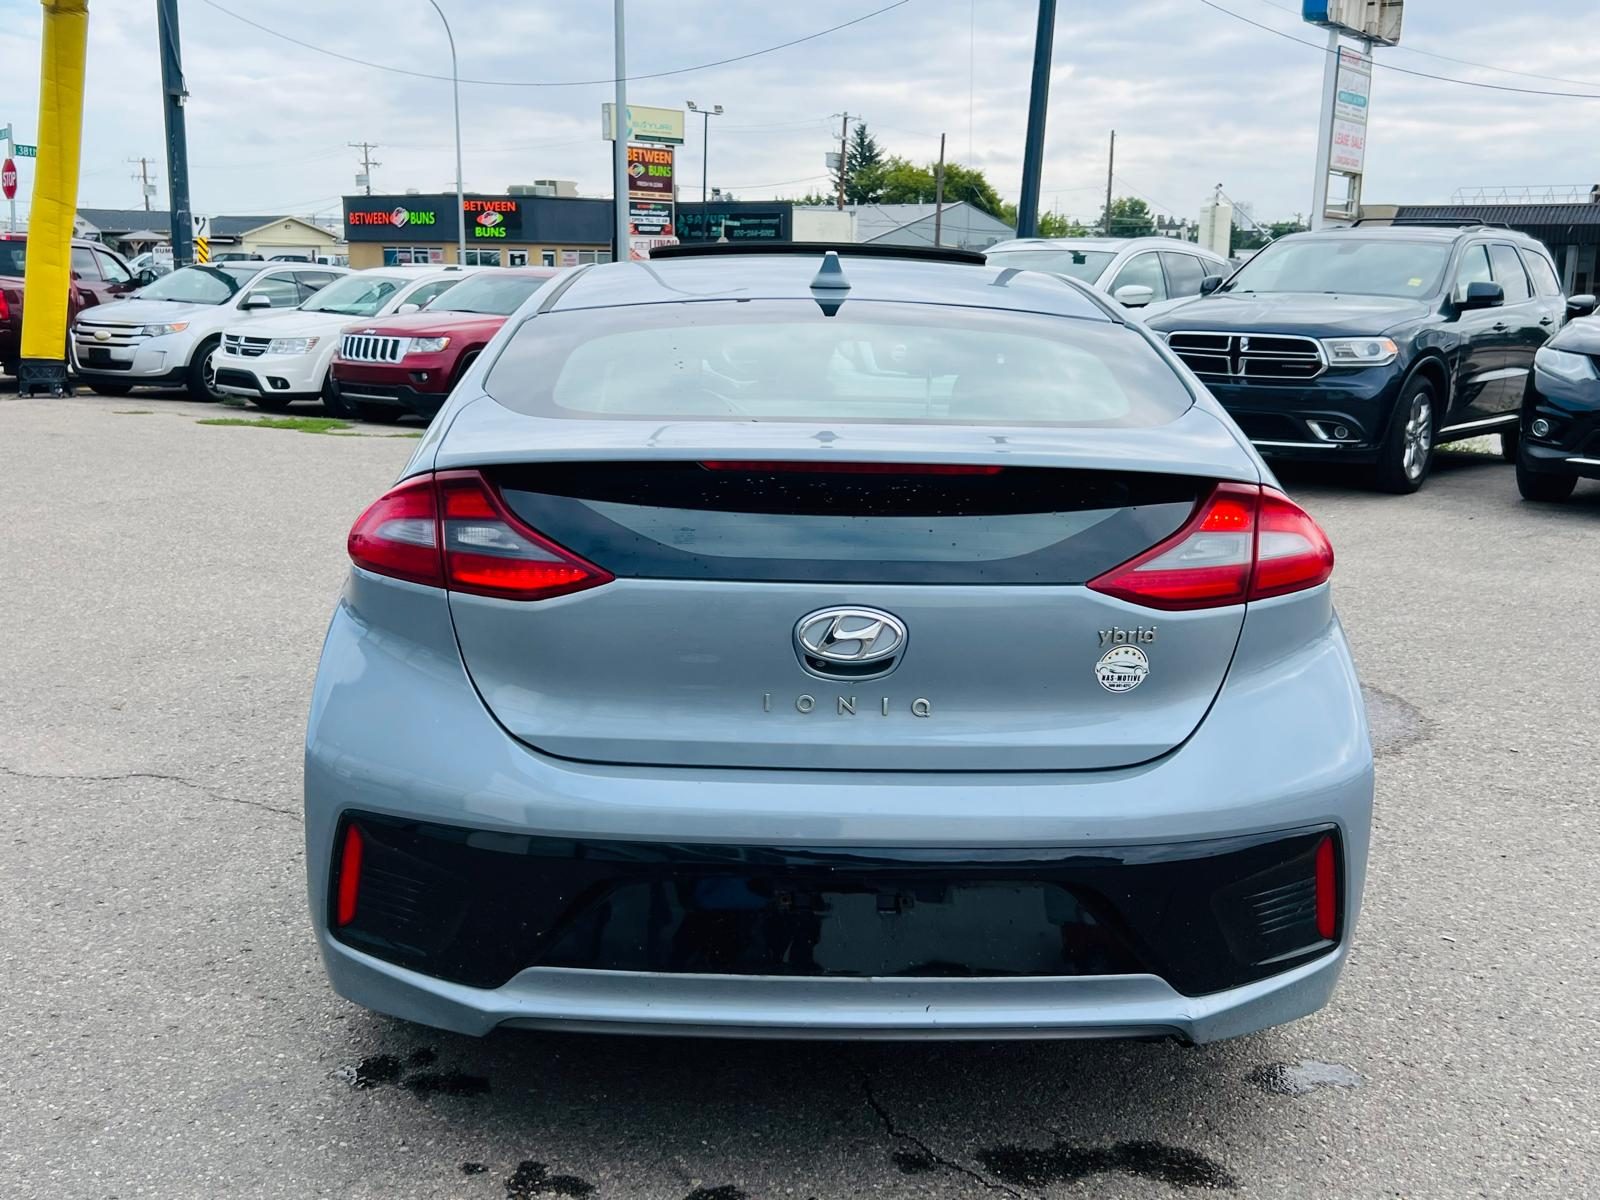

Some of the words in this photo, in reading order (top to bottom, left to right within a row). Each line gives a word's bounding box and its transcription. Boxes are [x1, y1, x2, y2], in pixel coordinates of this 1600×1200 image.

[627, 147, 672, 164] BETWEEN
[648, 165, 671, 177] BUNS
[3, 171, 16, 187] STOP
[463, 200, 516, 212] BETWEEN
[349, 212, 389, 225] BETWEEN
[410, 211, 435, 225] BUNS
[475, 227, 506, 238] BUNS
[1098, 625, 1157, 647] ybrid
[763, 693, 931, 718] IONIQ
